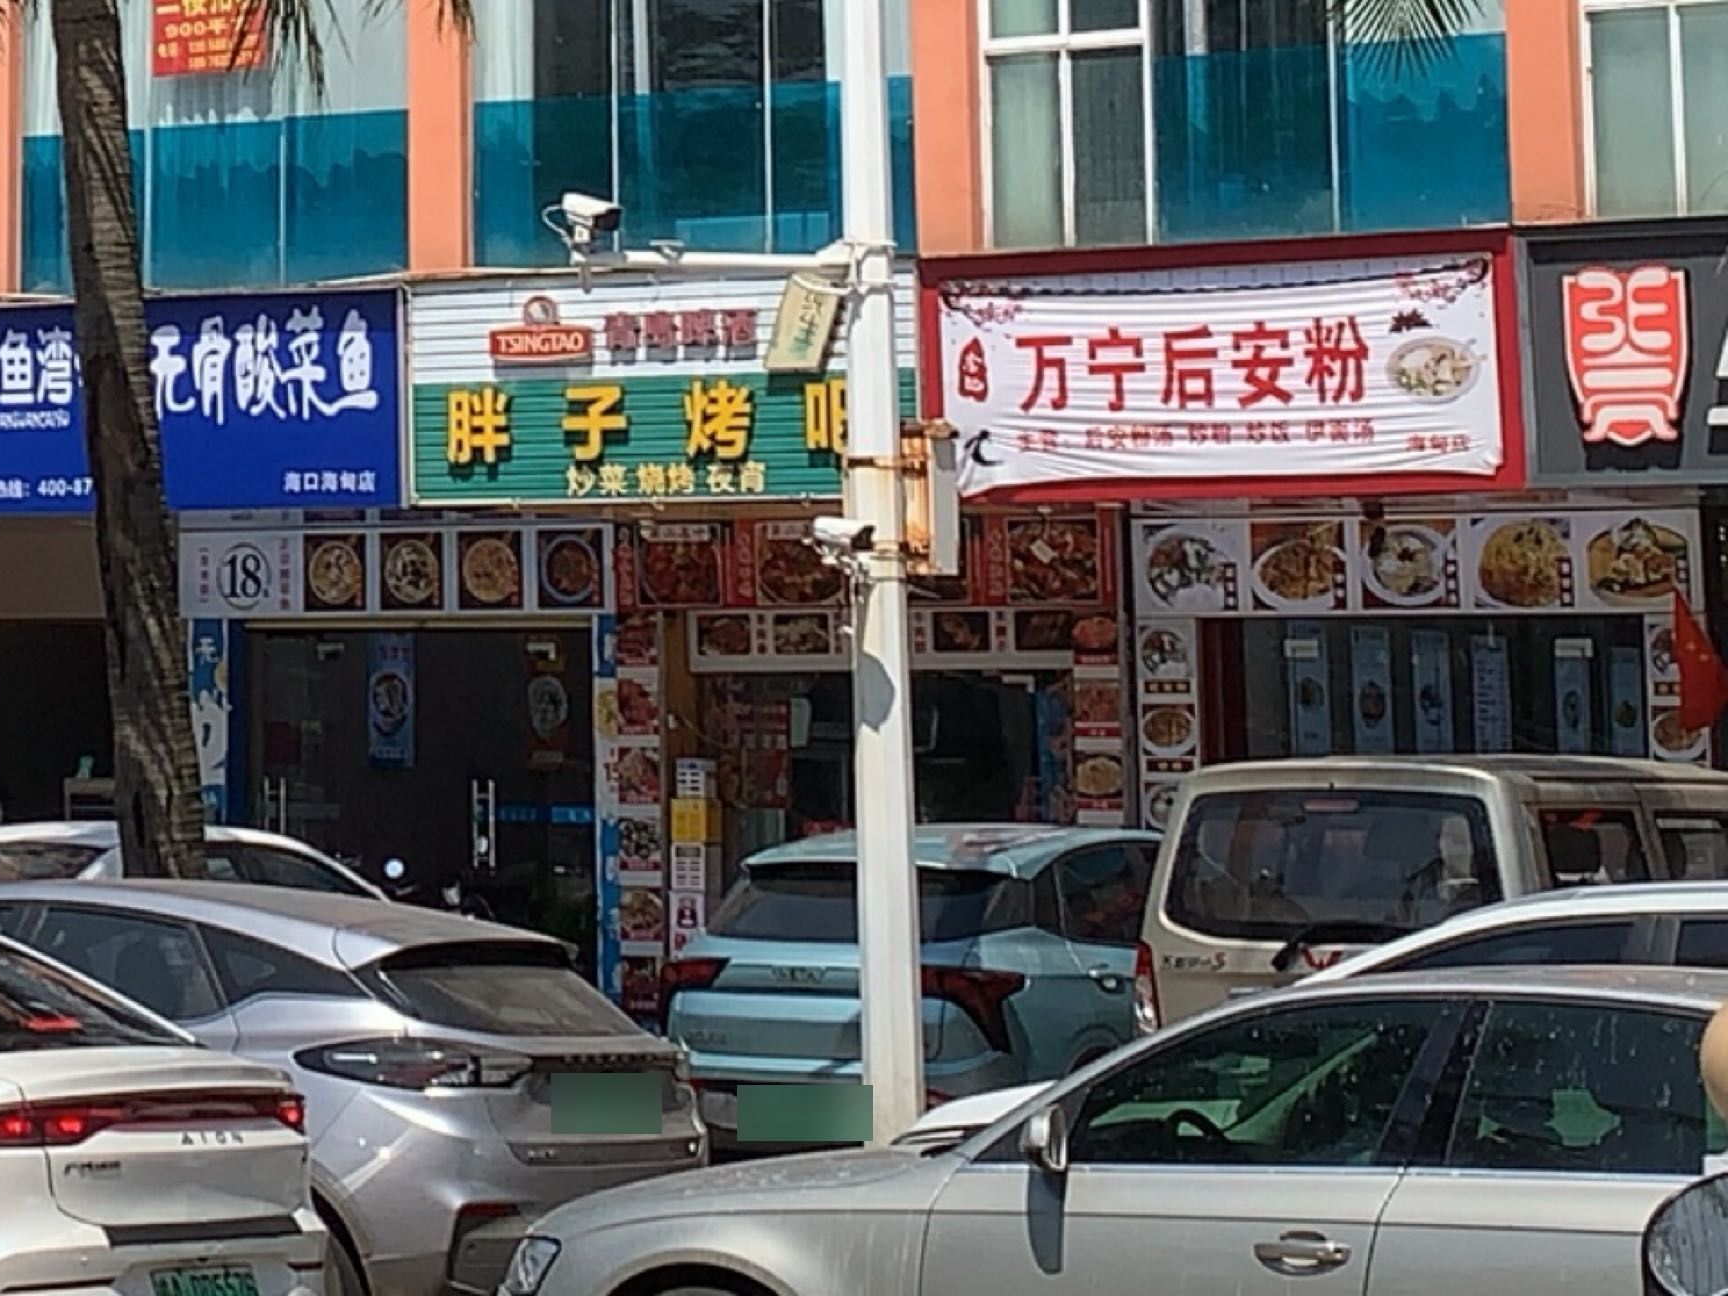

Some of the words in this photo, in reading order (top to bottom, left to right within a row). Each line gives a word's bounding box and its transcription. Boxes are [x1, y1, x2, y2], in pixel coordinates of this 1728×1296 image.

[149, 304, 380, 425] 无骨酸菜鱼
[495, 329, 587, 356] TSINGTAO
[1014, 313, 1372, 413] 万宁后安粉
[282, 470, 377, 494] 海口海甸店
